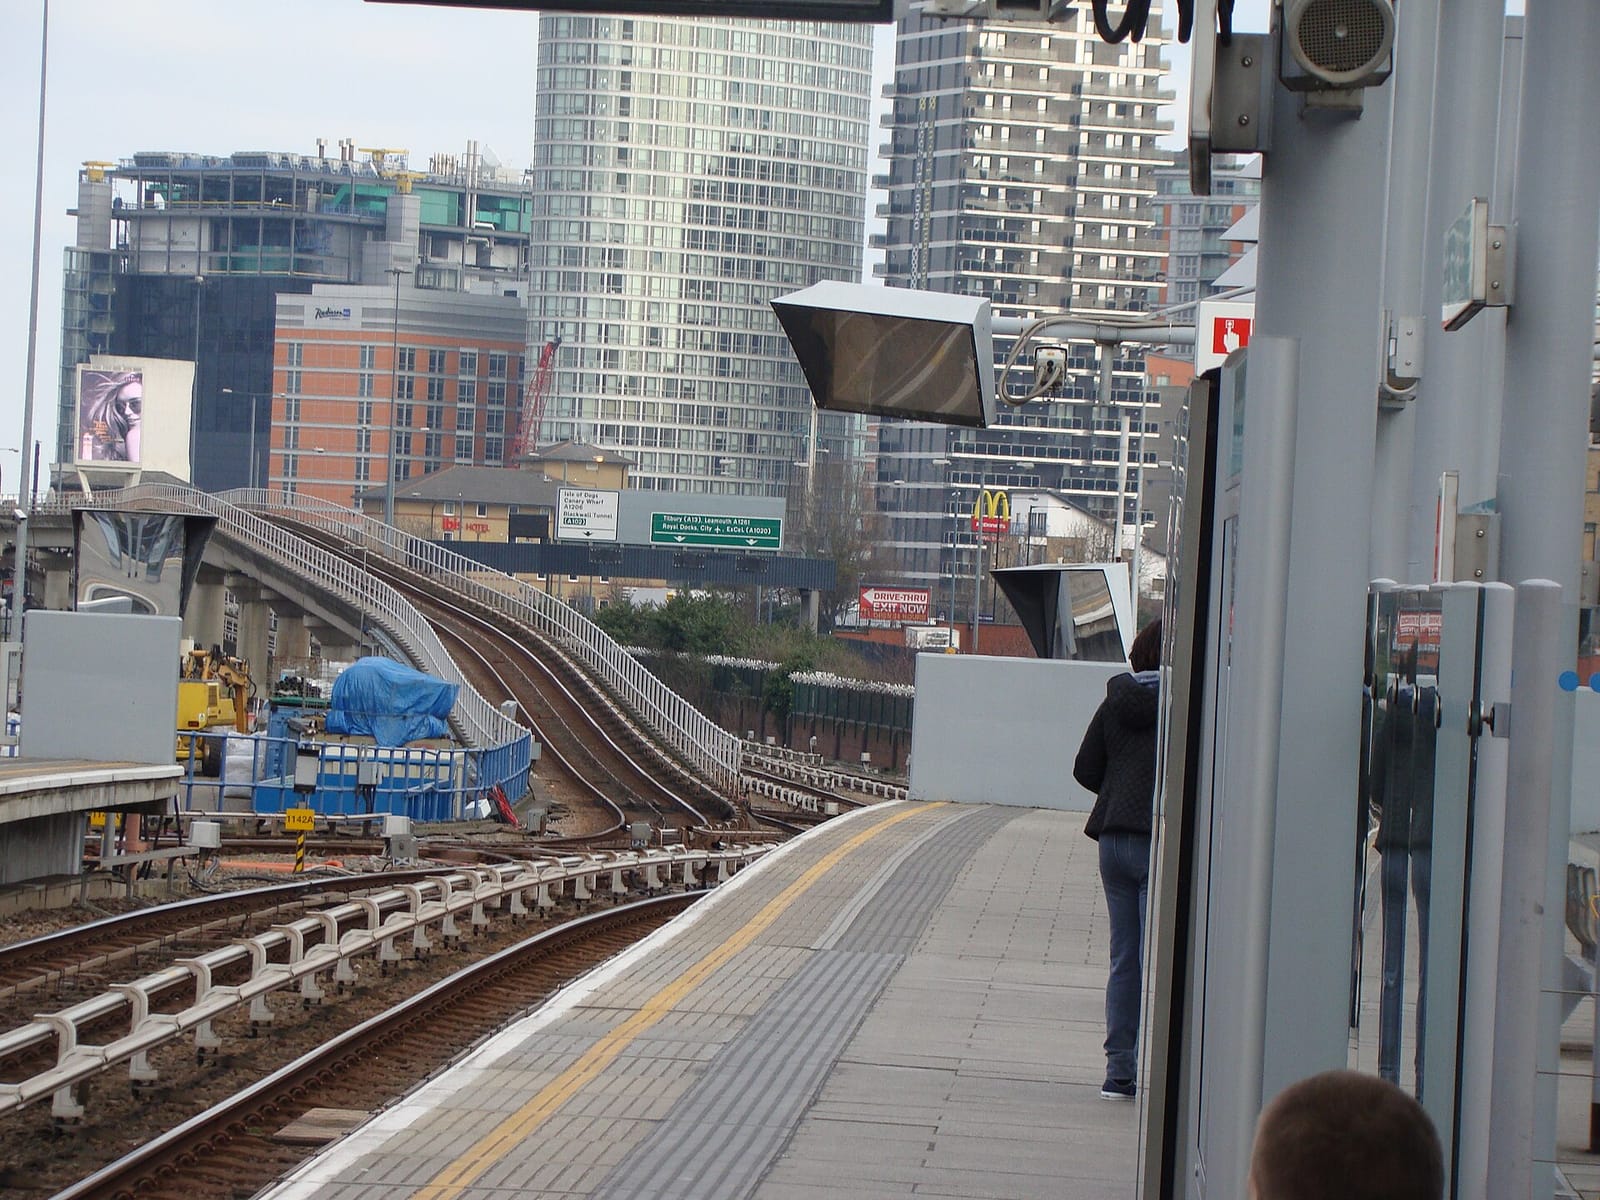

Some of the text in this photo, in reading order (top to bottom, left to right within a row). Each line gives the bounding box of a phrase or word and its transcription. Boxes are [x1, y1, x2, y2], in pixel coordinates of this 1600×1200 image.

[733, 518, 751, 526] A1261
[466, 522, 489, 532] HOTEL
[700, 525, 712, 533] City
[745, 526, 772, 535] (A1020)
[874, 593, 926, 602] DRIVE-THRU
[873, 602, 927, 614] EXIT NOW
[287, 815, 314, 824] 1142A
